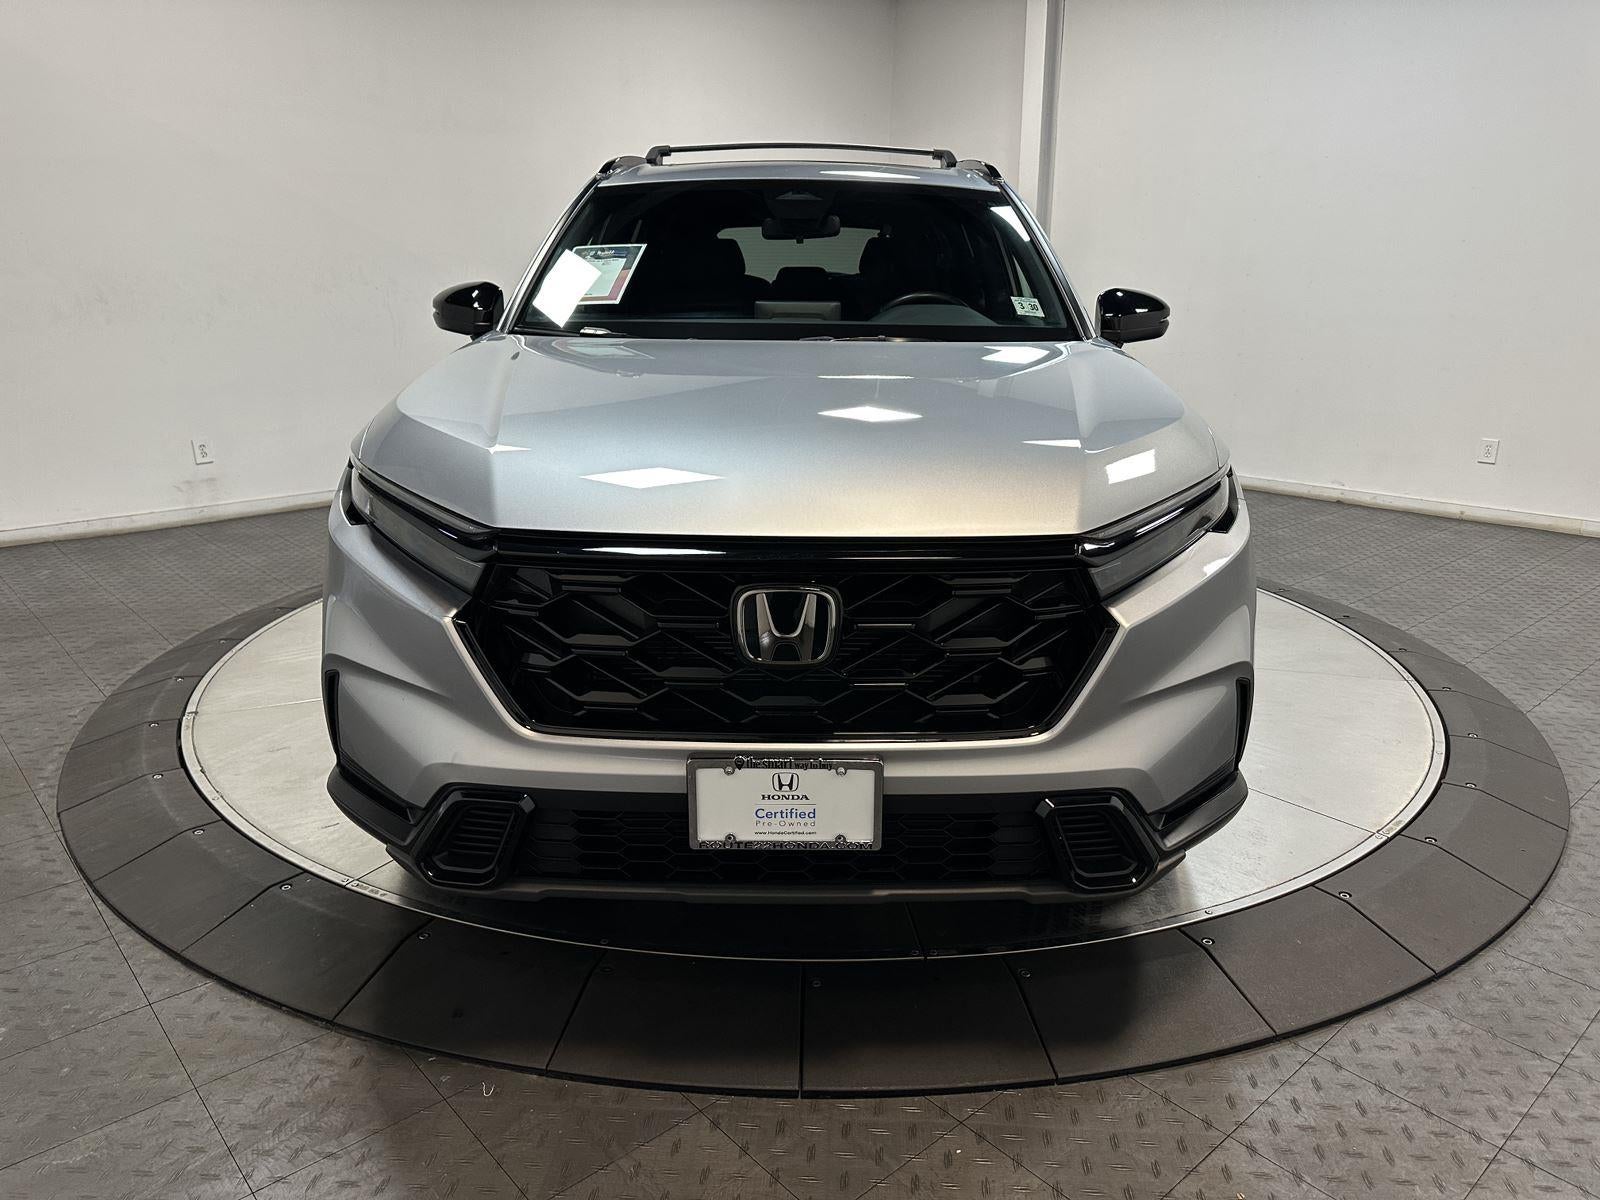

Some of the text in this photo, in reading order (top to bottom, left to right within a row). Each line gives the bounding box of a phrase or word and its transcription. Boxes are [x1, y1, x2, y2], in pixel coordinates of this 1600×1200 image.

[1018, 302, 1039, 311] 3 30
[746, 756, 832, 771] the smart way to buy
[755, 808, 816, 819] Certified
